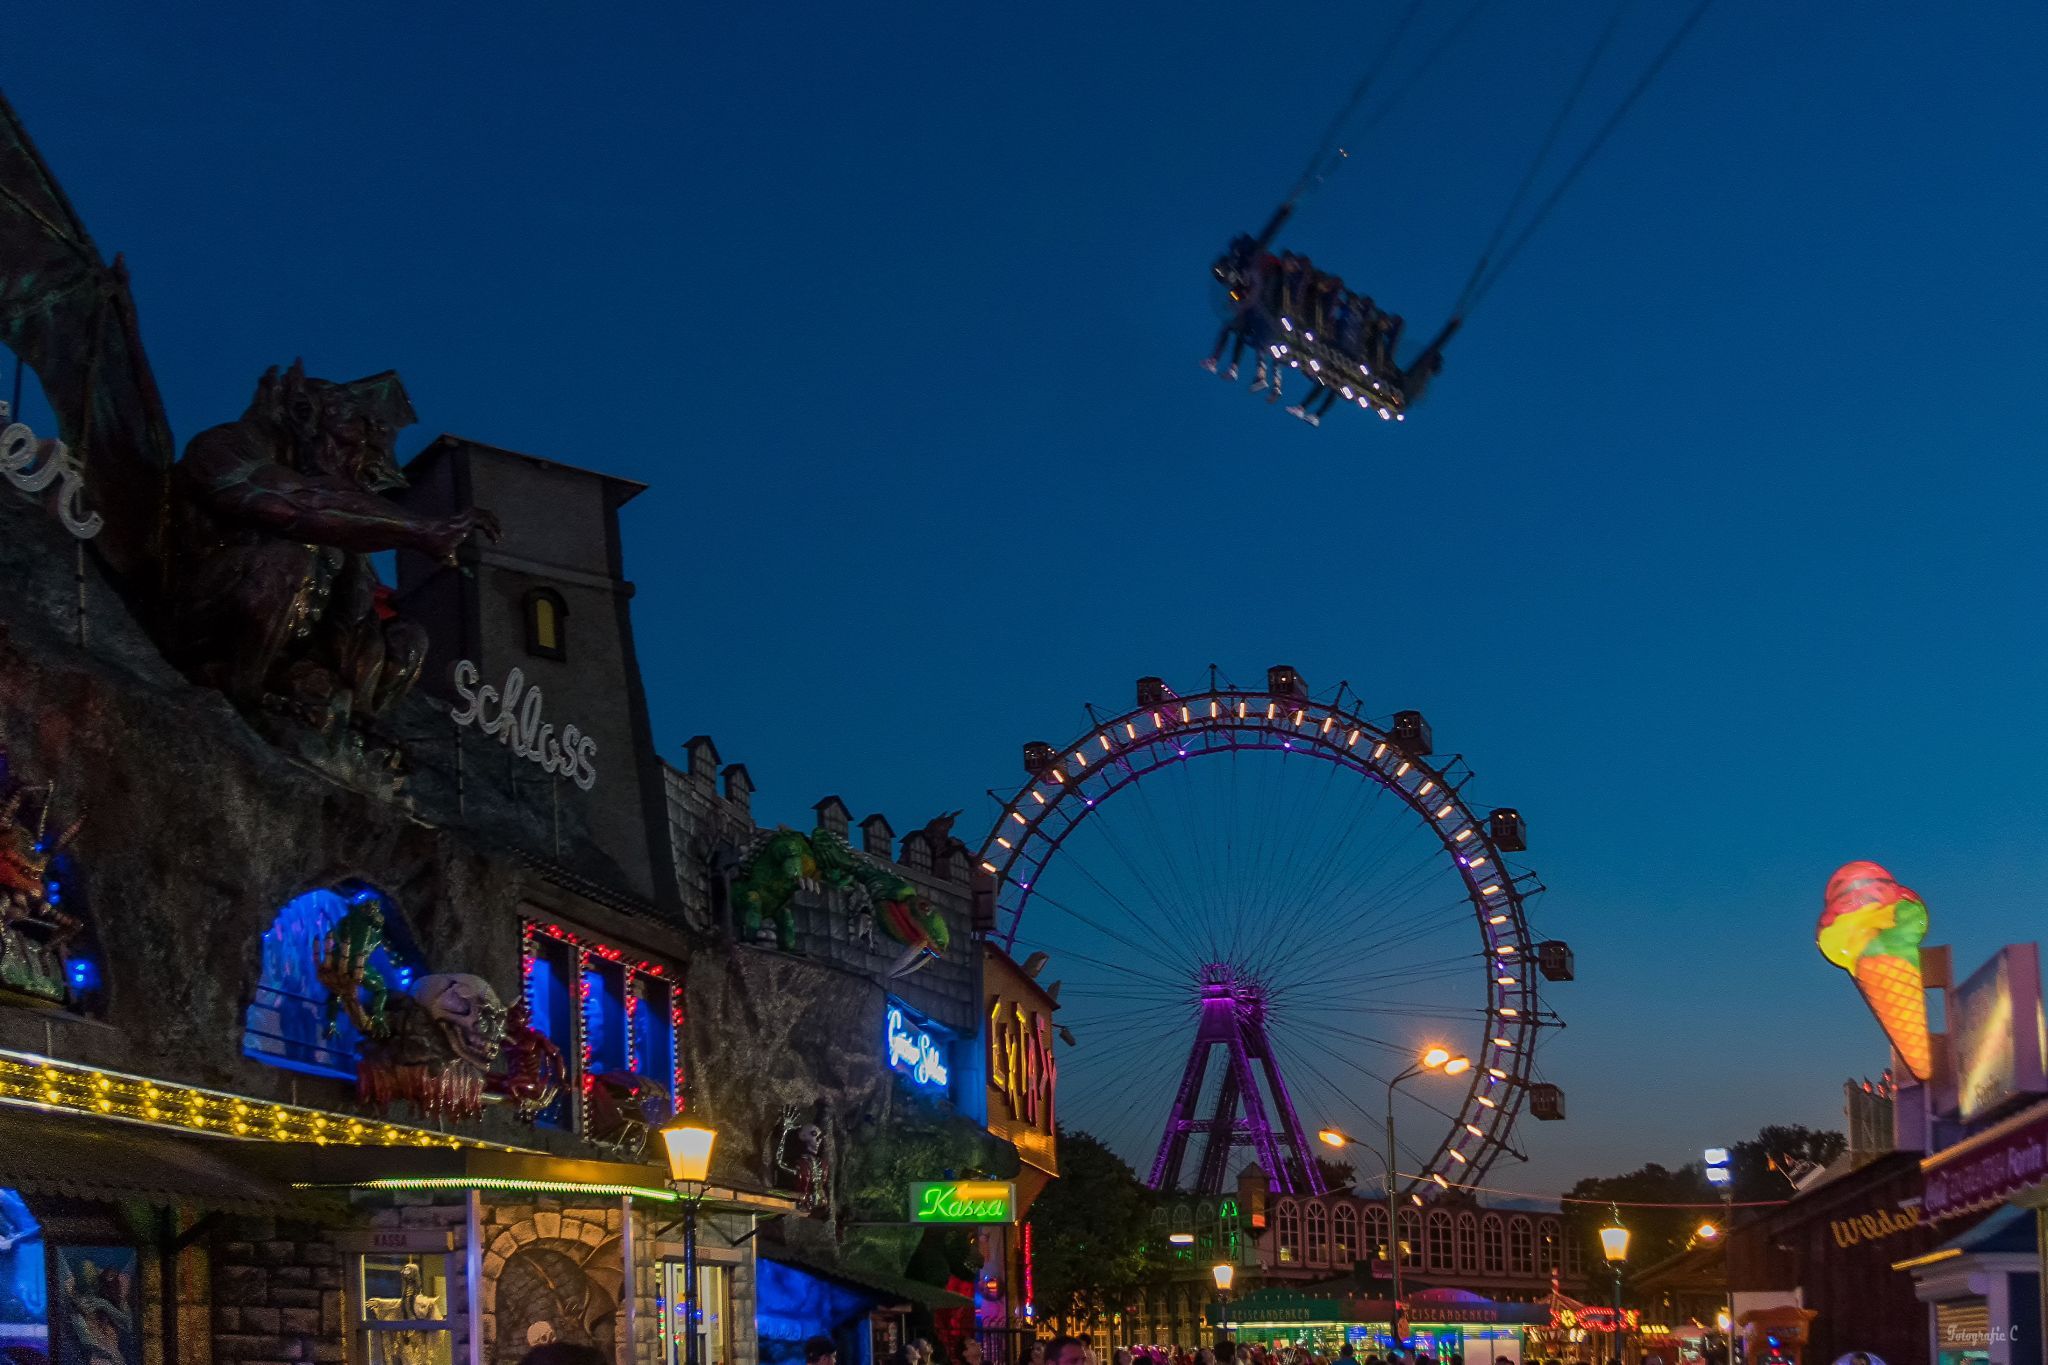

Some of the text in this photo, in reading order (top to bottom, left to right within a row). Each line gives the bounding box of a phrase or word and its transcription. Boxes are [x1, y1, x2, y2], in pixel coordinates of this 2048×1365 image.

[0, 400, 597, 791] er Schloss
[918, 1185, 1003, 1217] Kassa
